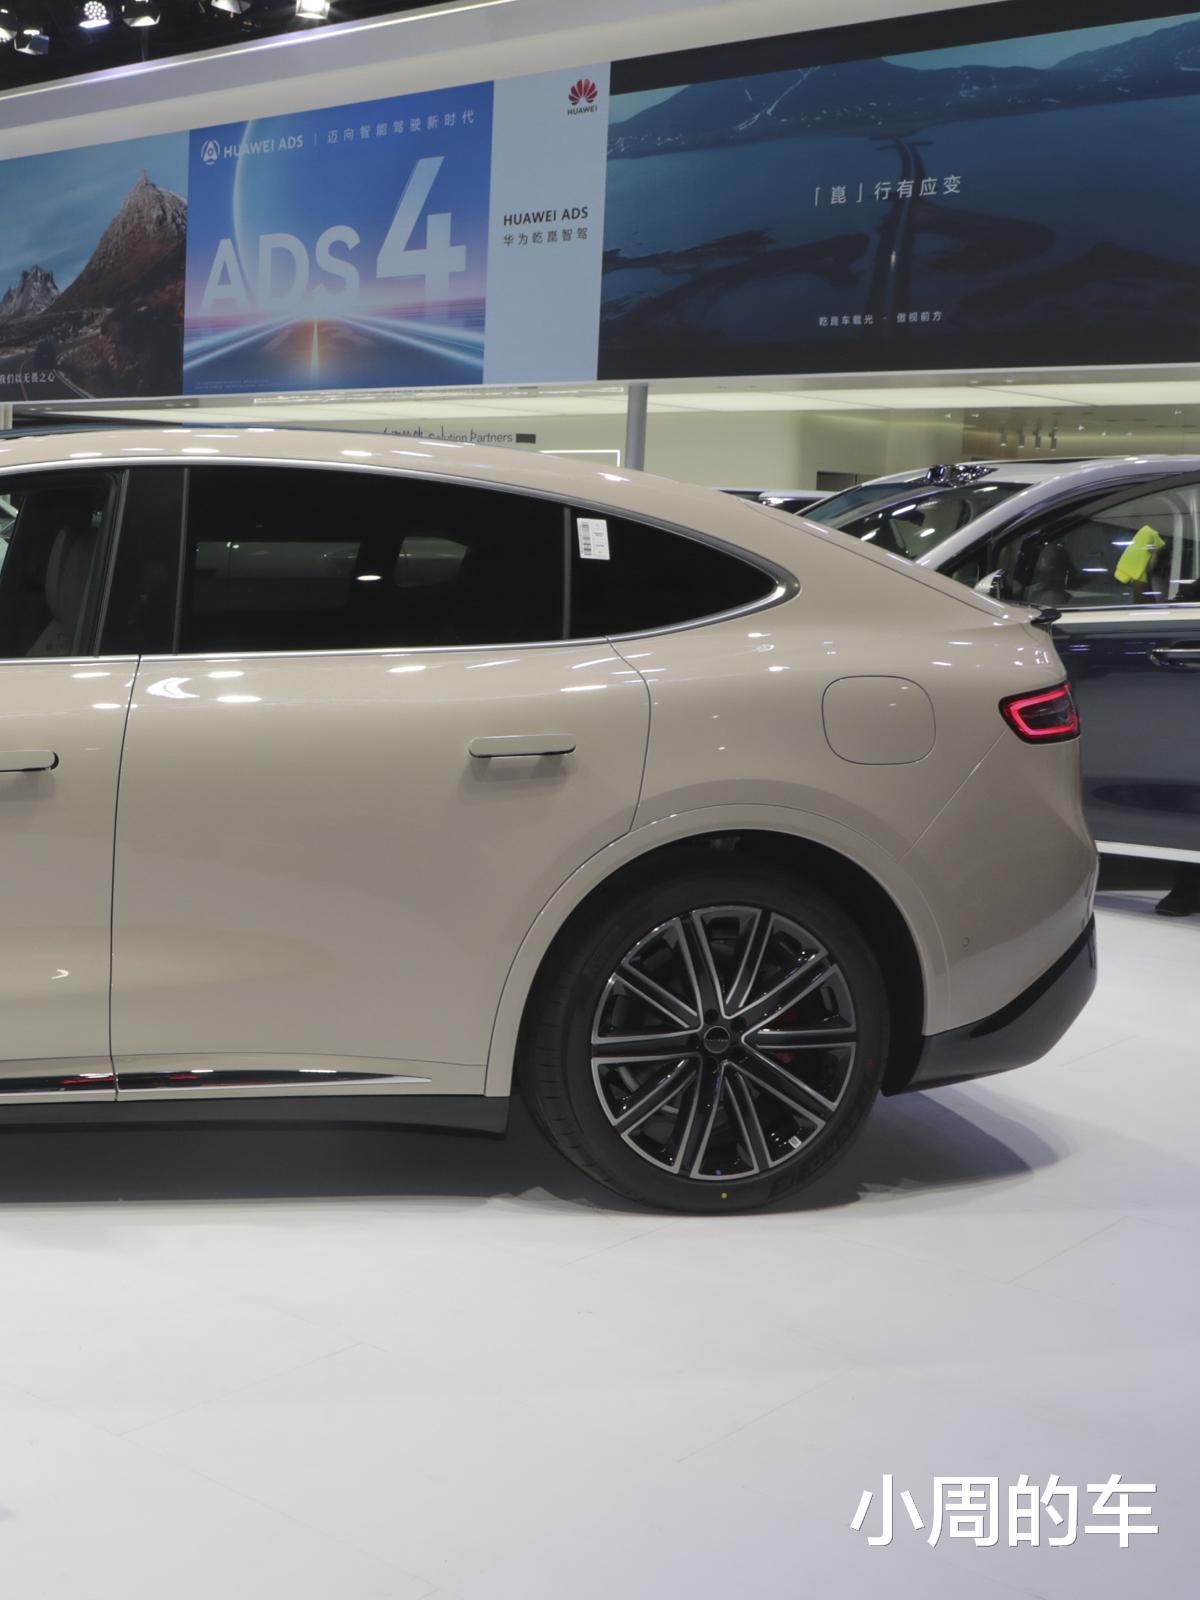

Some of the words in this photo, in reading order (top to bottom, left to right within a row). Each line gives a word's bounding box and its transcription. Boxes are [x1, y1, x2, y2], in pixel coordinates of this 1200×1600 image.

[567, 105, 598, 117] HUAWEI
[224, 137, 275, 160] HUAWEI
[278, 134, 304, 152] ADS
[326, 109, 476, 145] 迈向智能驾驶新时代
[503, 209, 557, 226] HUAWEI
[561, 206, 589, 221] ADS
[200, 224, 361, 316] ADS
[375, 155, 467, 299] 4
[503, 227, 589, 247] 华为乾崑智驾
[470, 429, 513, 444] Partners
